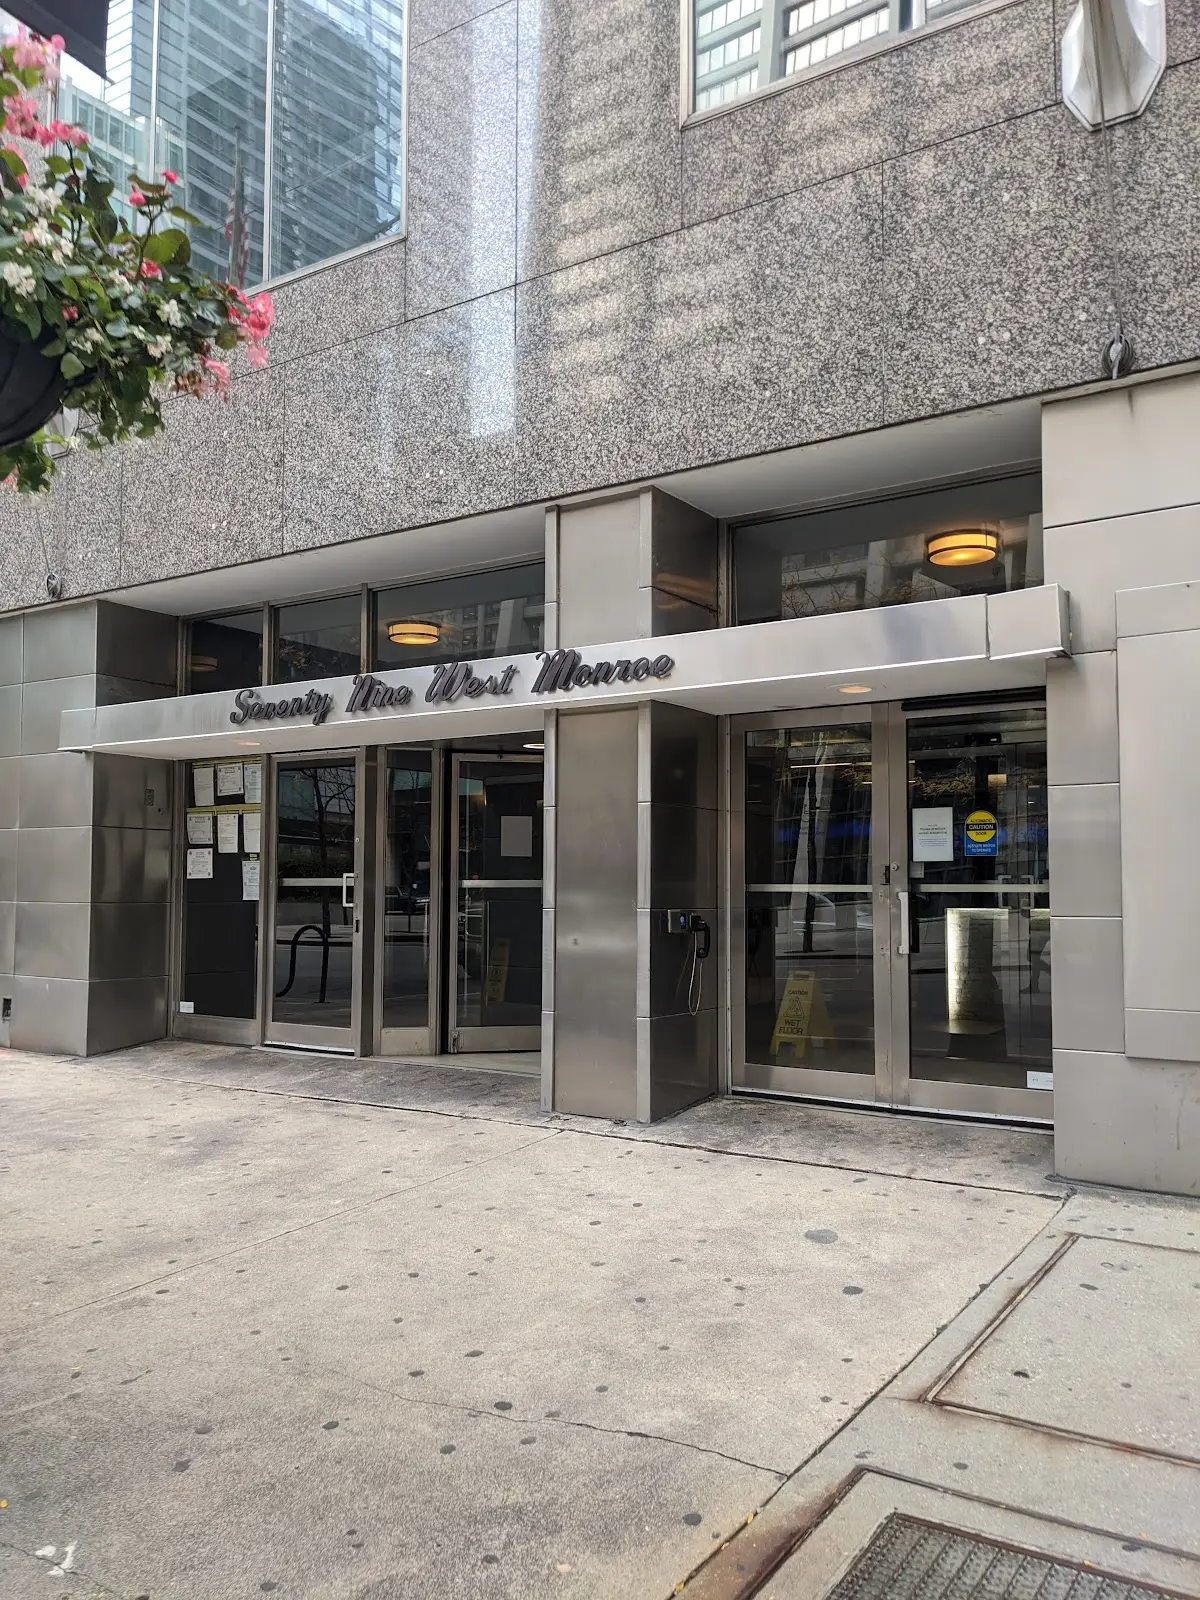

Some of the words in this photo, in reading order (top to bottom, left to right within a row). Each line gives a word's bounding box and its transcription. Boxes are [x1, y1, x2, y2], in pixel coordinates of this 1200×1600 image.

[230, 688, 332, 726] Seventy
[345, 674, 412, 713] Nine
[424, 661, 518, 703] West
[531, 649, 675, 694] Monroe
[784, 1018, 801, 1027] WET
[779, 1026, 804, 1036] FLOOR
